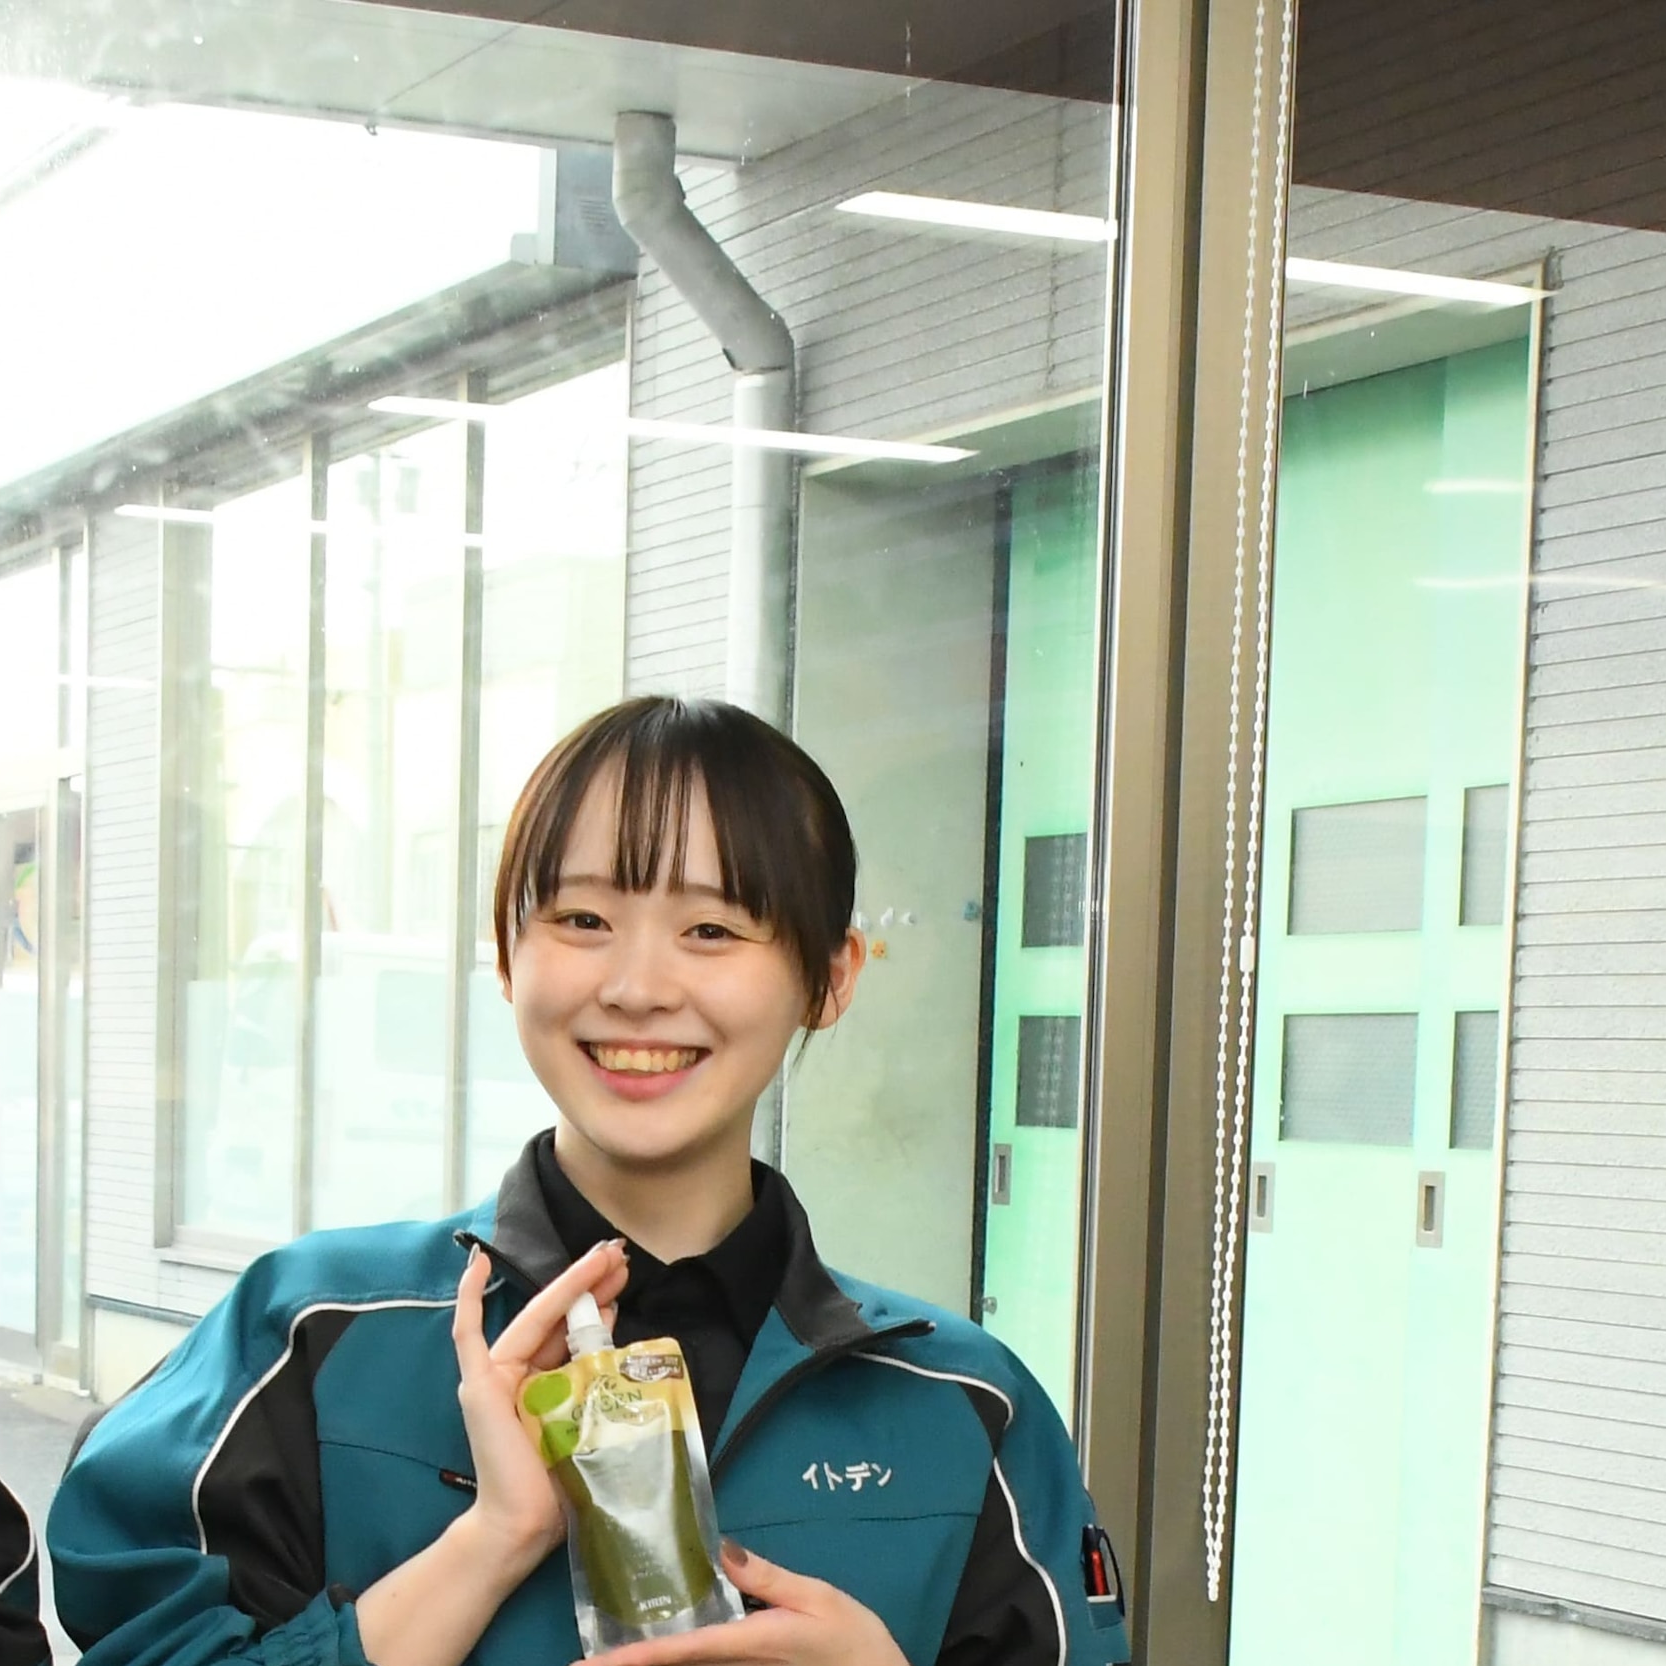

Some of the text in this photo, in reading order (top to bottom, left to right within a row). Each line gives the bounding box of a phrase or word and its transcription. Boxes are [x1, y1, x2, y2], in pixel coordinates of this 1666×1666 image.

[802, 1461, 892, 1491] イトデン
[639, 1595, 672, 1611] KIRIN
